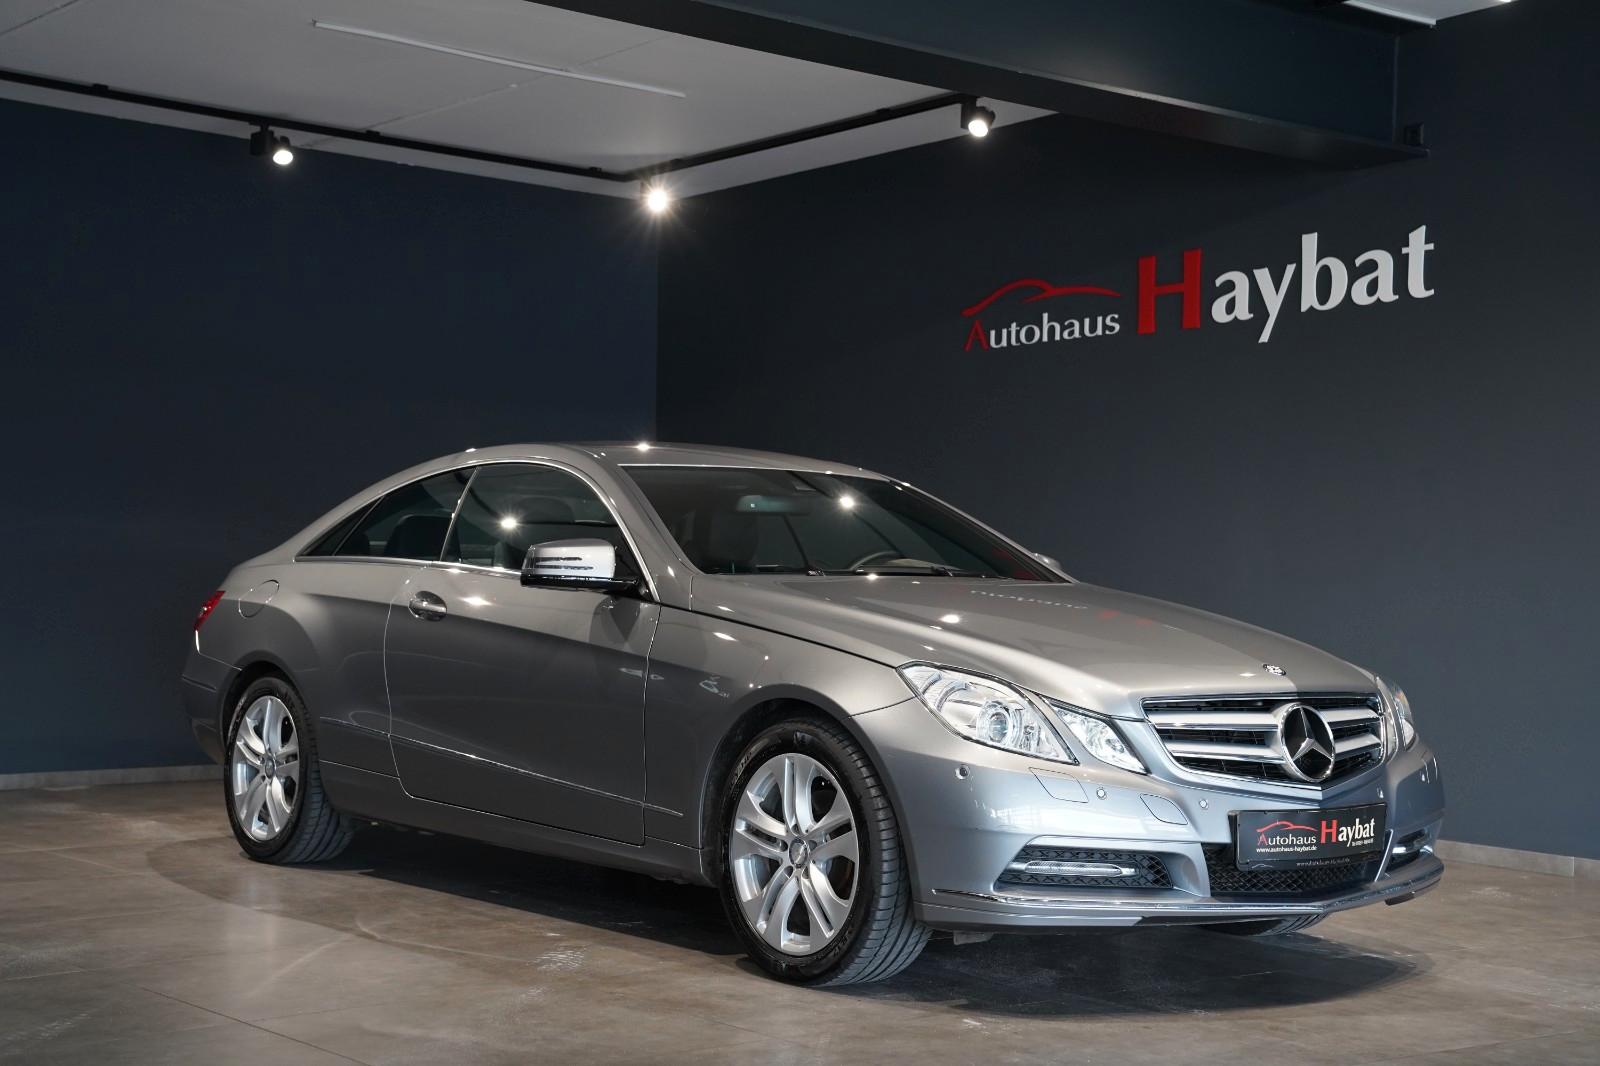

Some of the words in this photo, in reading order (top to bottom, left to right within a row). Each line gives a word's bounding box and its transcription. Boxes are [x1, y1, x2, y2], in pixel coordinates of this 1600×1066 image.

[964, 312, 1120, 351] Autohaus
[1137, 225, 1435, 343] Haybat
[1257, 833, 1317, 846] Autohaus
[1320, 818, 1375, 847] Haybat
[1256, 845, 1317, 853] www.autohaus-haybat.de
